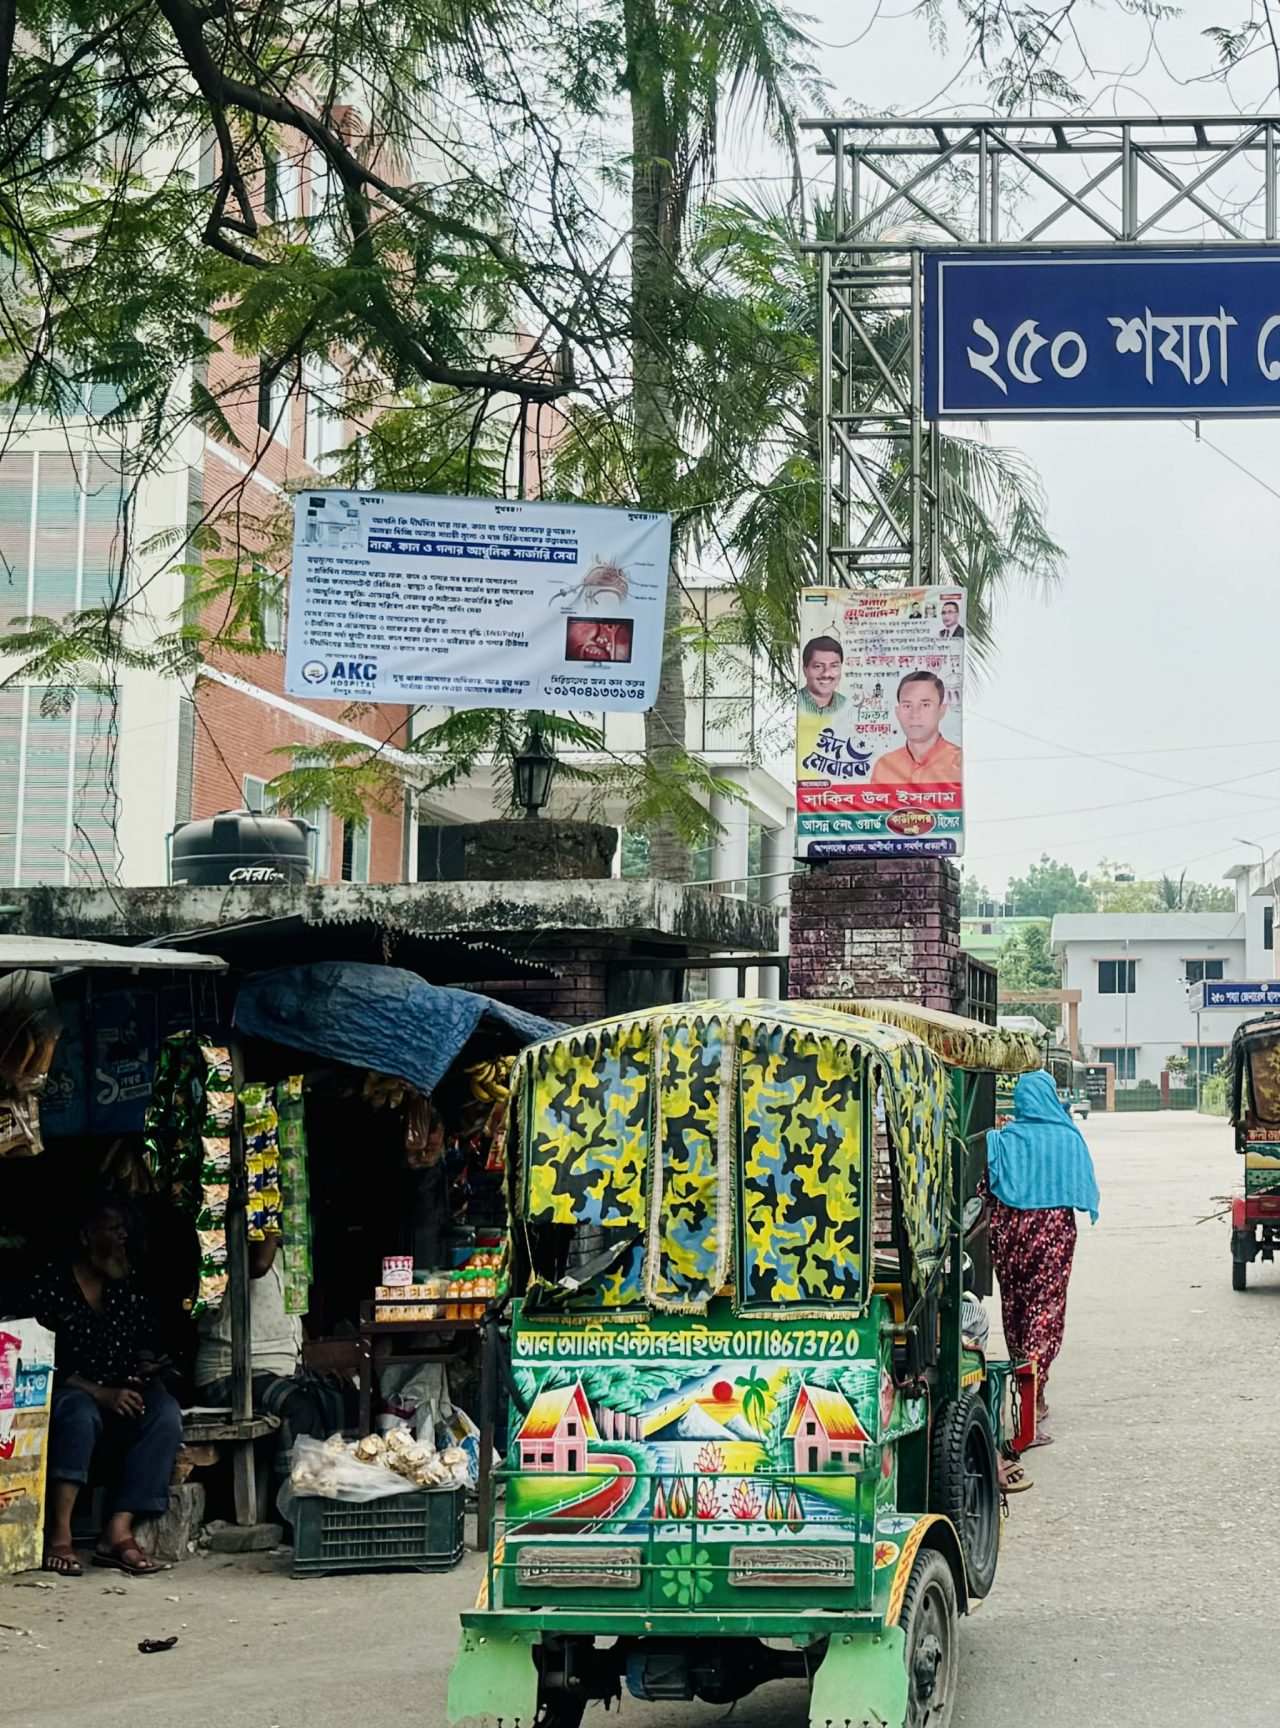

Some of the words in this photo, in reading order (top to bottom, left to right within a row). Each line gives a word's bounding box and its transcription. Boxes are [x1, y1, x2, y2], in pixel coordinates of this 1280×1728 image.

[966, 316, 1088, 392] ২৫০
[1110, 315, 1236, 389] শয্যা
[369, 540, 396, 552] নাক,
[398, 542, 420, 553] কান
[423, 543, 432, 553] ও
[436, 544, 464, 556] গলার
[466, 545, 511, 560] আধুনিক
[512, 547, 551, 560] সার্জারি
[553, 551, 576, 561] সেবা
[332, 661, 377, 681] AKC
[331, 679, 376, 689] HOSPITAL
[554, 686, 645, 699] ০১৭০৪১৩৩১৩৪
[816, 727, 846, 760] ঈদ
[802, 751, 873, 780] মোবারক
[803, 790, 856, 806] সাকিব
[861, 789, 891, 805] উল
[896, 789, 957, 805] ইসলাম
[802, 819, 831, 833] আসন্ন
[832, 819, 853, 831] ৫নং
[856, 816, 882, 830] ওয়ার্ড
[229, 867, 275, 882] সেরা
[1211, 992, 1225, 1004] ২৫০
[516, 1330, 558, 1356] আল
[557, 1324, 617, 1357] আমিন
[615, 1323, 734, 1357] এন্টারপ্রাইজ
[732, 1329, 860, 1358] 01718673720
